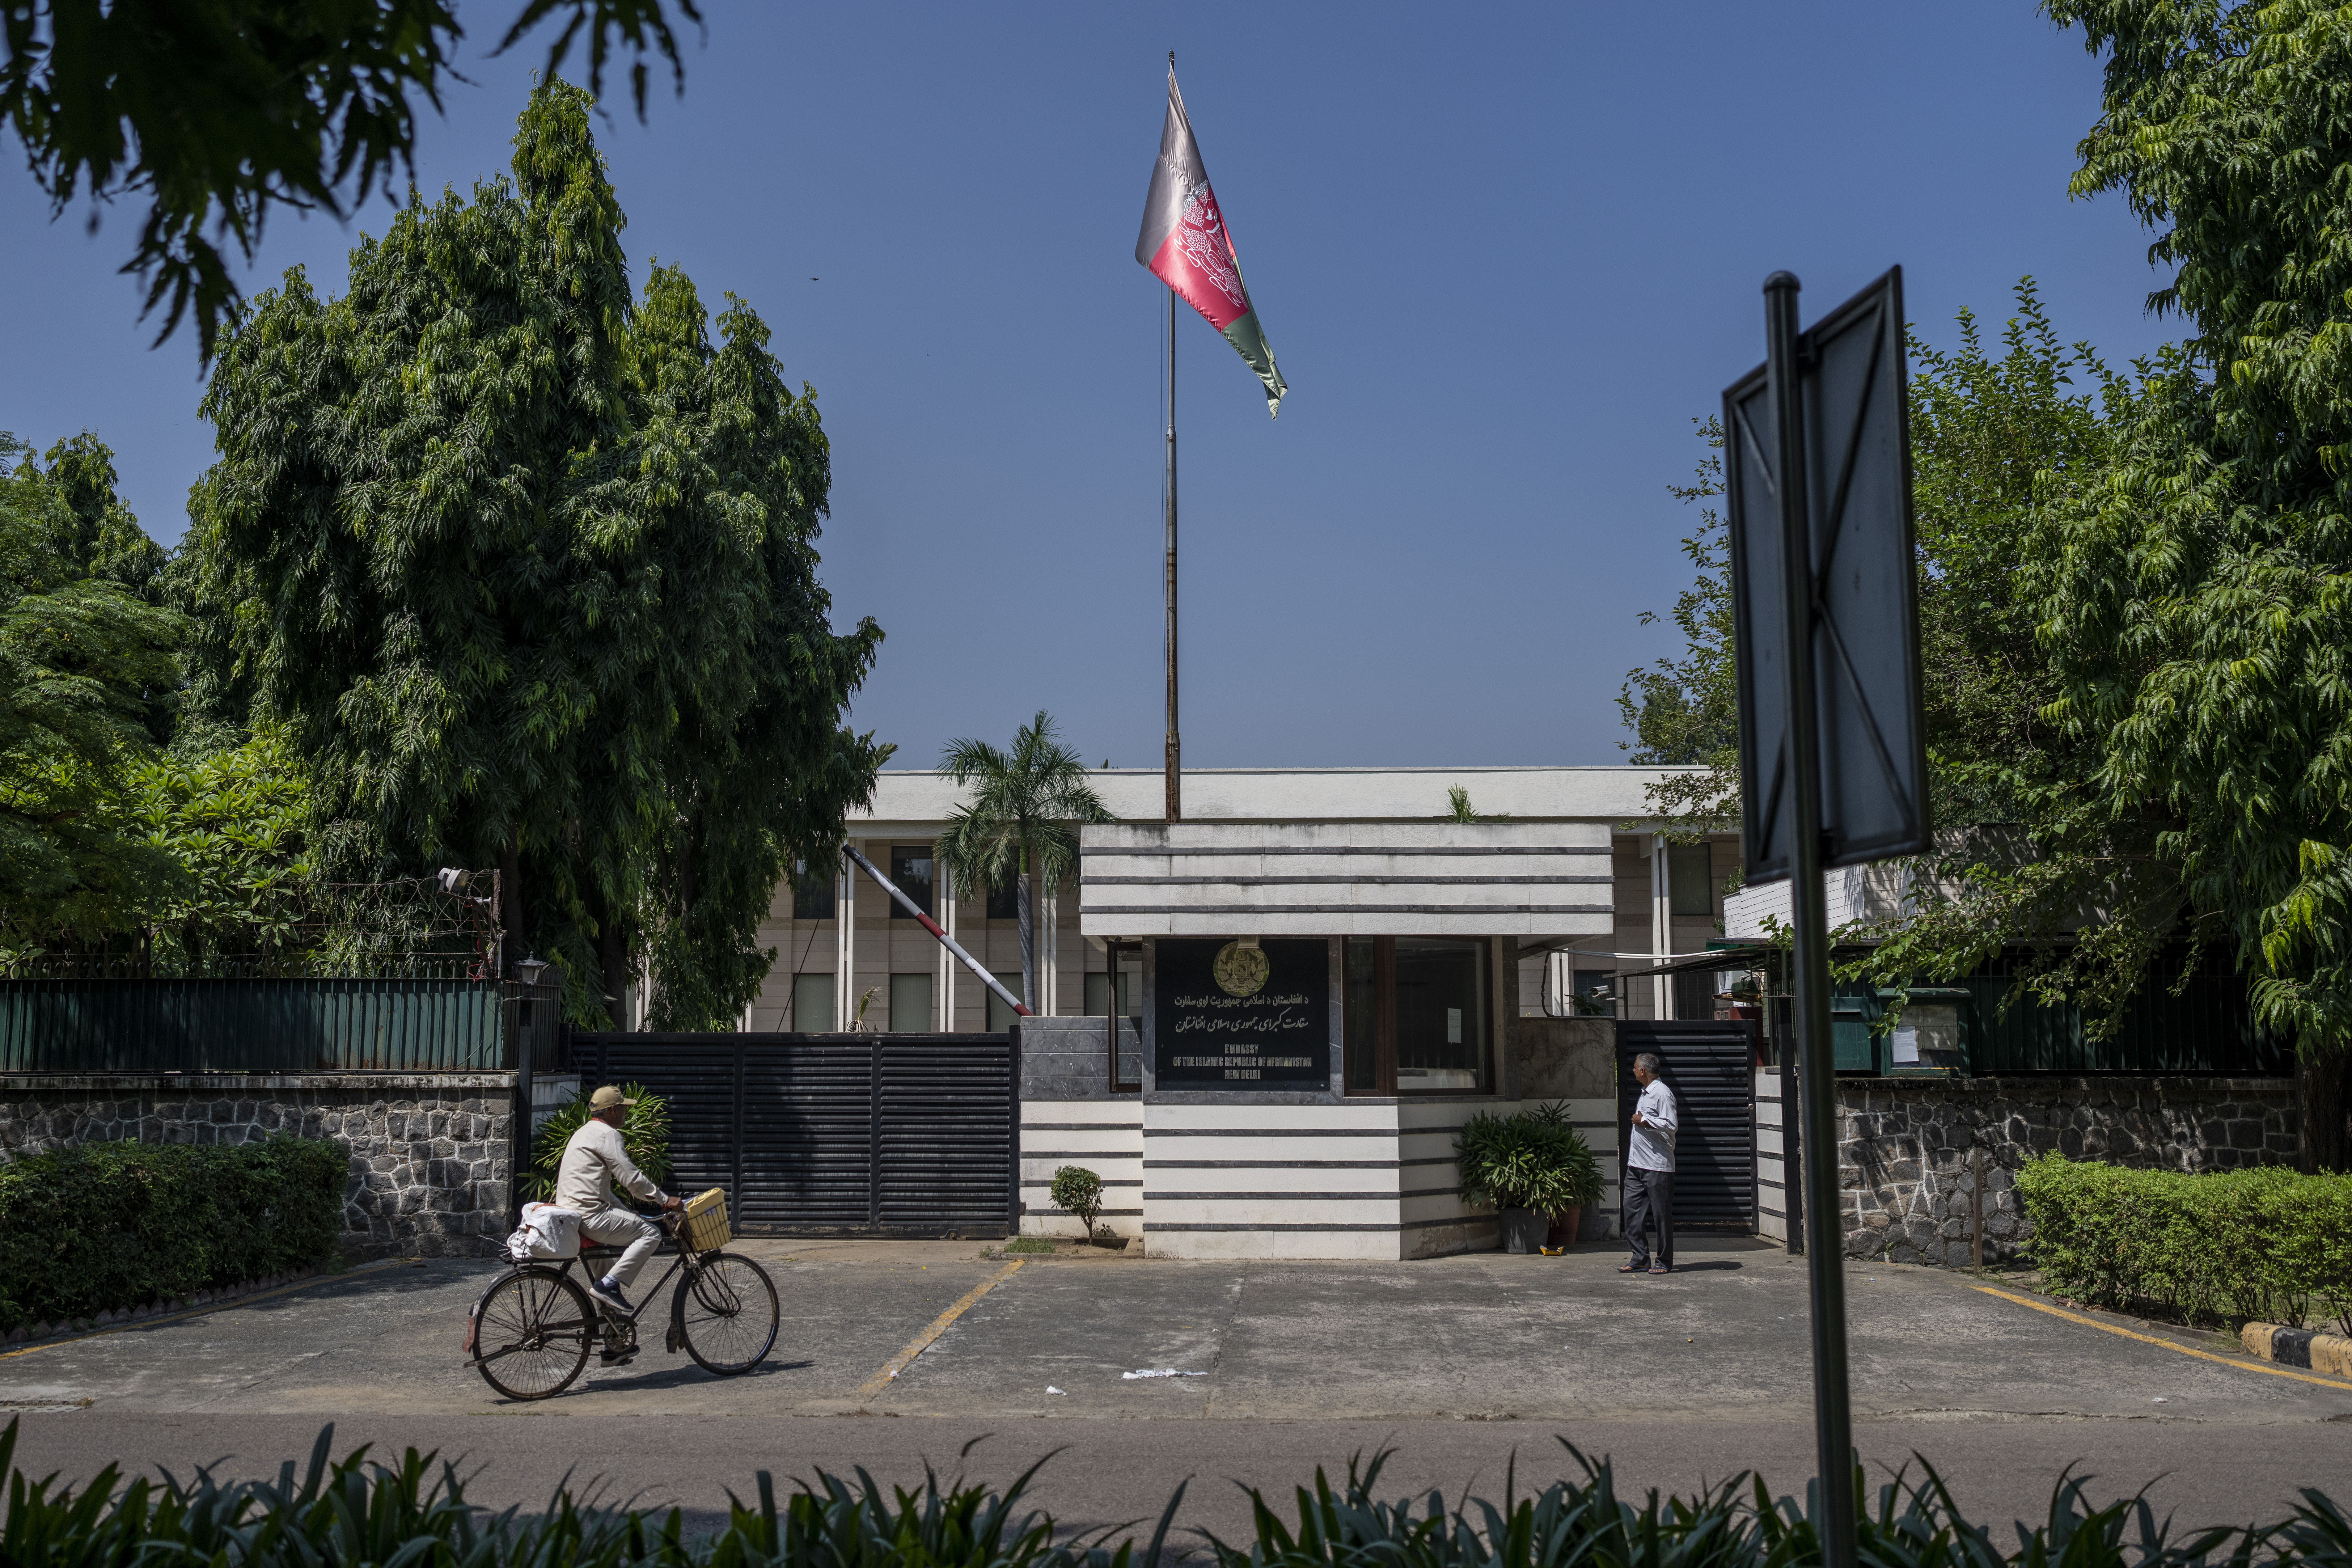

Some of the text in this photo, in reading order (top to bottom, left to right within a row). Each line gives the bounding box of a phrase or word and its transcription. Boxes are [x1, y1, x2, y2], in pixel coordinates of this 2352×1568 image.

[1198, 253, 1223, 280] افغانستان
[1175, 995, 1196, 1007] سفارت
[1210, 996, 1241, 1008] جمهوریت
[1273, 993, 1302, 1006] افغانستان
[1176, 1006, 1309, 1033] سفارت کبرای جمهوری اسلامی افغانستان
[1225, 1044, 1259, 1054] EMBASSY
[1173, 1057, 1312, 1067] OF THE ISLAMIC REPUBLIC OF AFGHANISTAN
[1224, 1069, 1260, 1079] NEW DELHI
